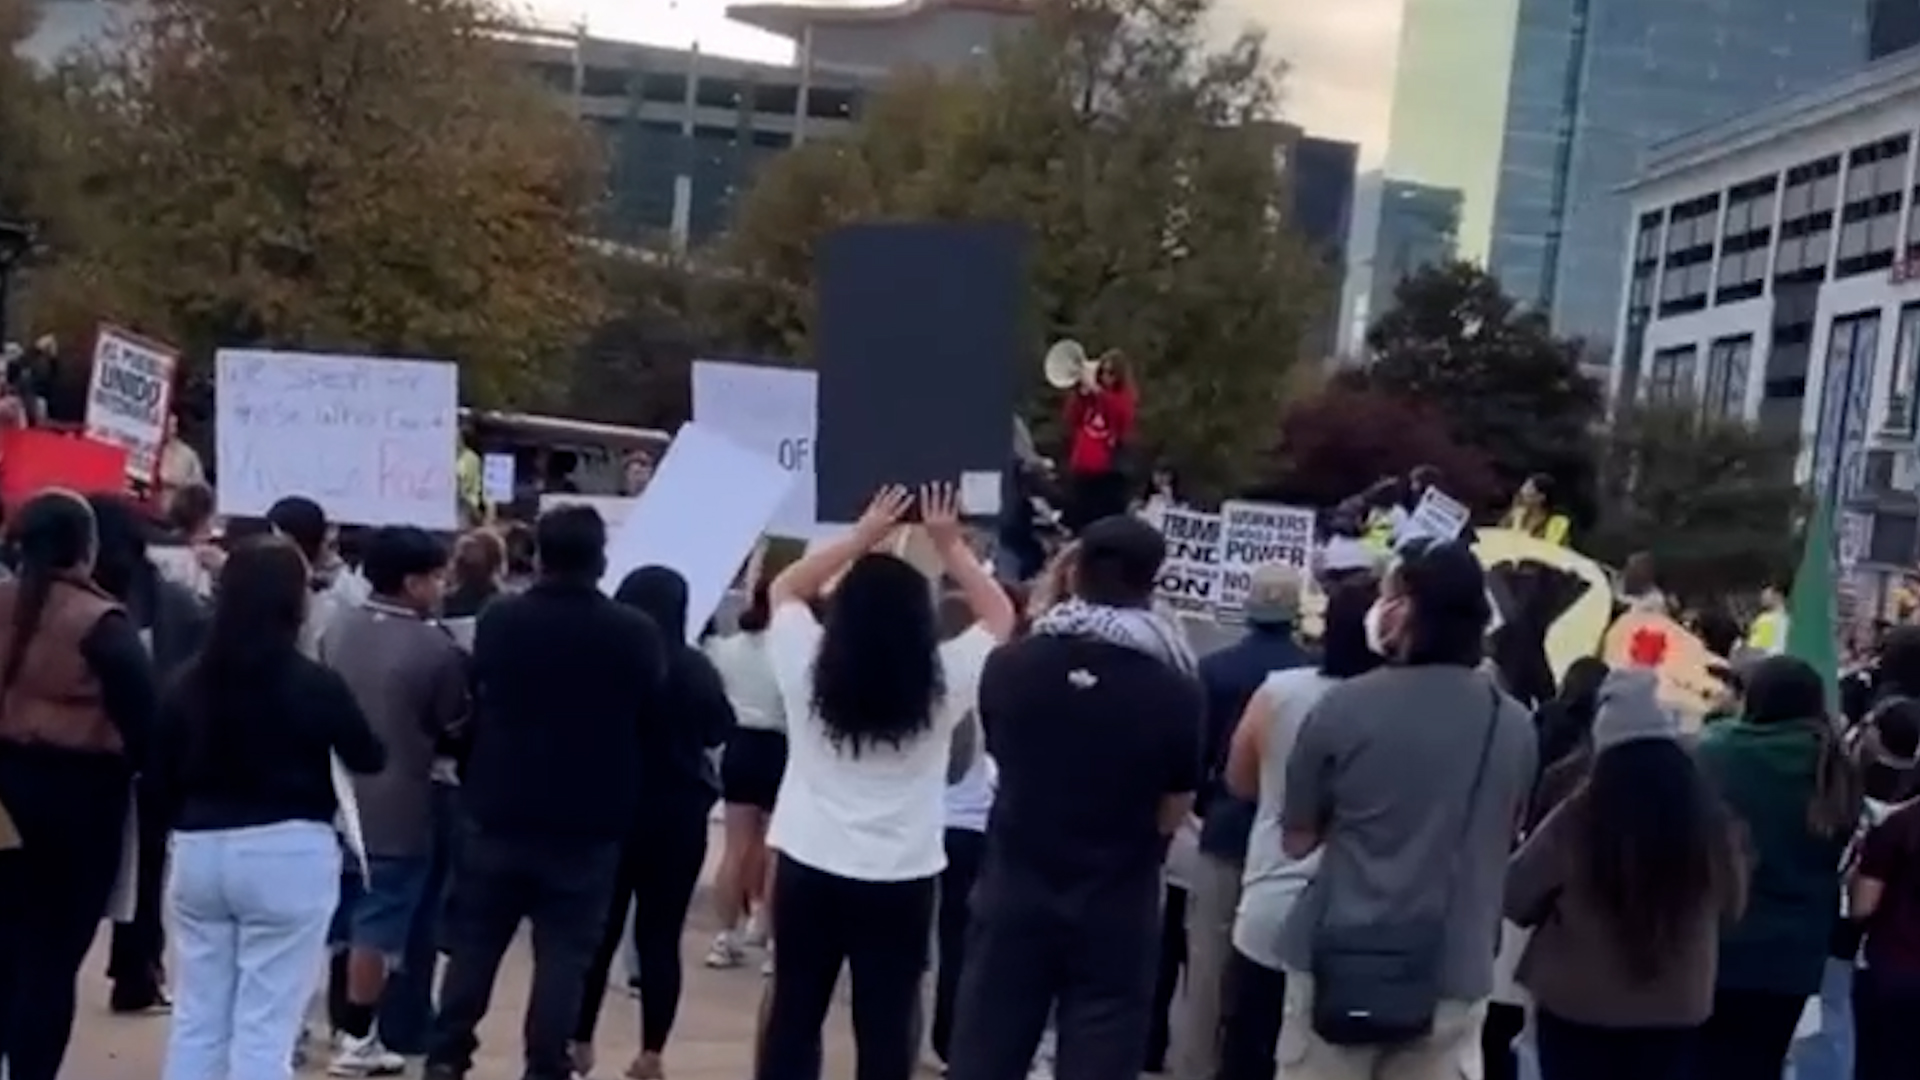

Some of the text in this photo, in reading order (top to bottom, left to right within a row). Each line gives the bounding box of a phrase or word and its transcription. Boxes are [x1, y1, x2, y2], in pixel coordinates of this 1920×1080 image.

[101, 361, 161, 409] UNIDO
[777, 436, 809, 473] OF
[1225, 540, 1306, 568] POWER
